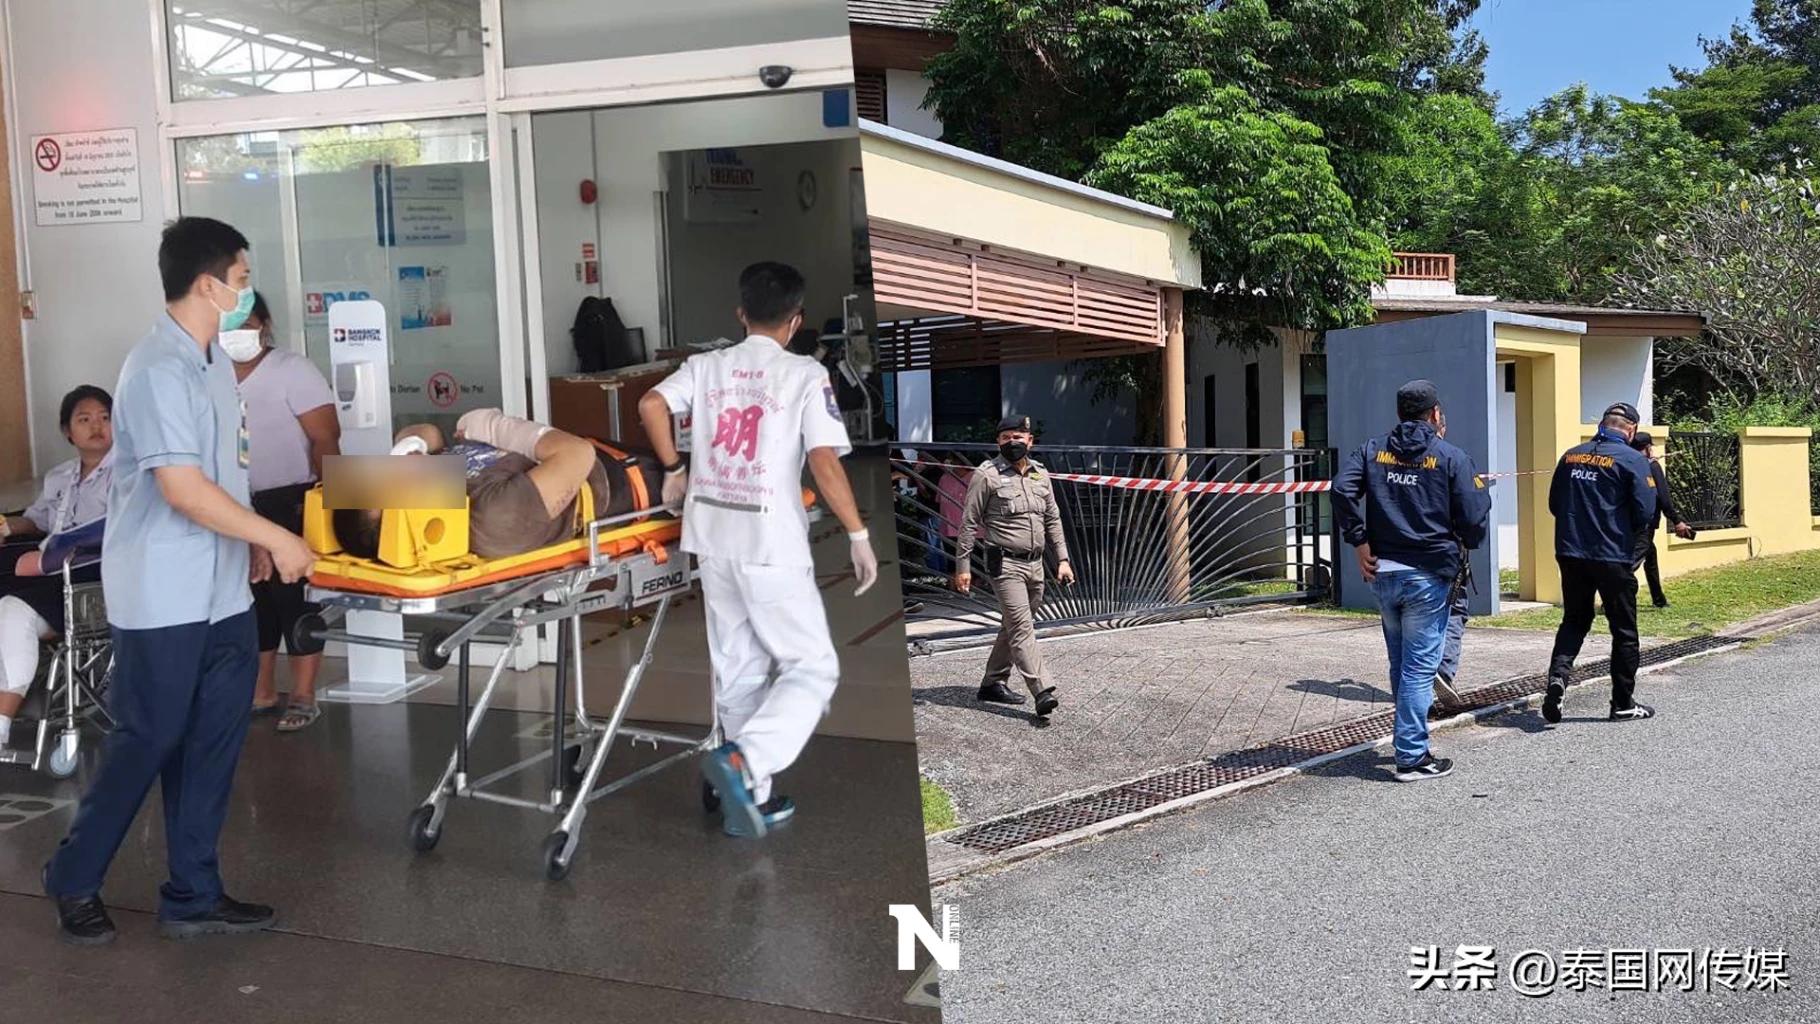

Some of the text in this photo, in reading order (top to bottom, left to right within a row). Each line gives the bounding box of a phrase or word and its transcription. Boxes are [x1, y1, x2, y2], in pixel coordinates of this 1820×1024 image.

[711, 404, 764, 462] 明
[1566, 453, 1615, 468] IMMIGRATION
[1387, 471, 1418, 485] POLICE
[1571, 469, 1599, 481] POLICE
[642, 571, 683, 593] FERNO
